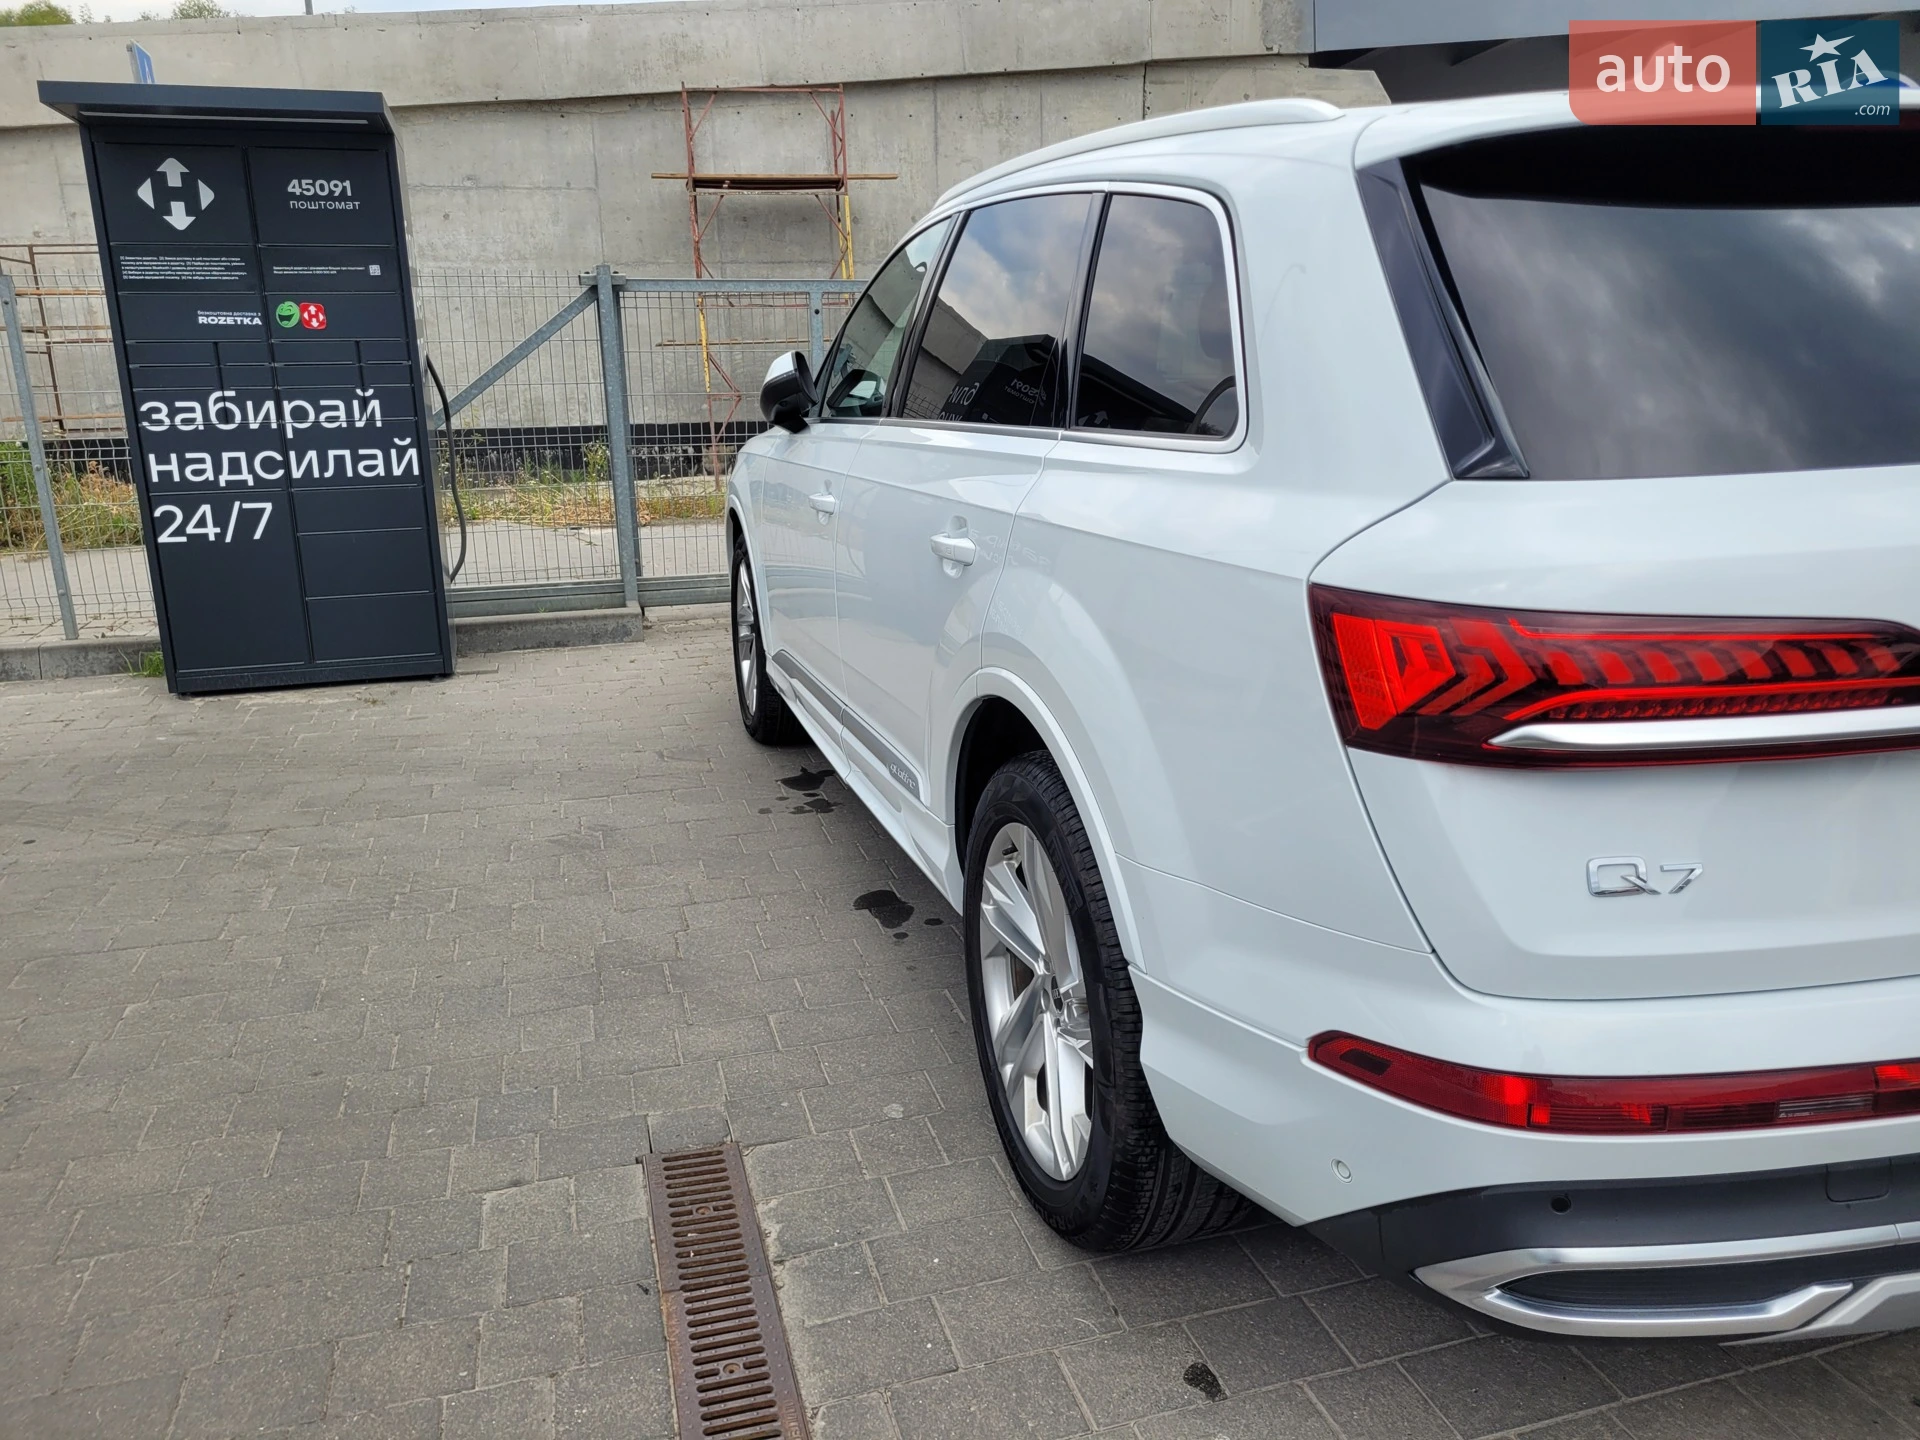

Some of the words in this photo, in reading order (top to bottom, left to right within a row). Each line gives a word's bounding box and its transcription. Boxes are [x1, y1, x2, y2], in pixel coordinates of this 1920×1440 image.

[287, 179, 352, 197] 45091
[289, 200, 361, 210] поштомат
[198, 316, 263, 325] ROZETKA
[139, 388, 383, 439] забирай
[148, 437, 420, 487] надсилай
[153, 501, 274, 543] 24/7
[1586, 855, 1704, 897] Q7
